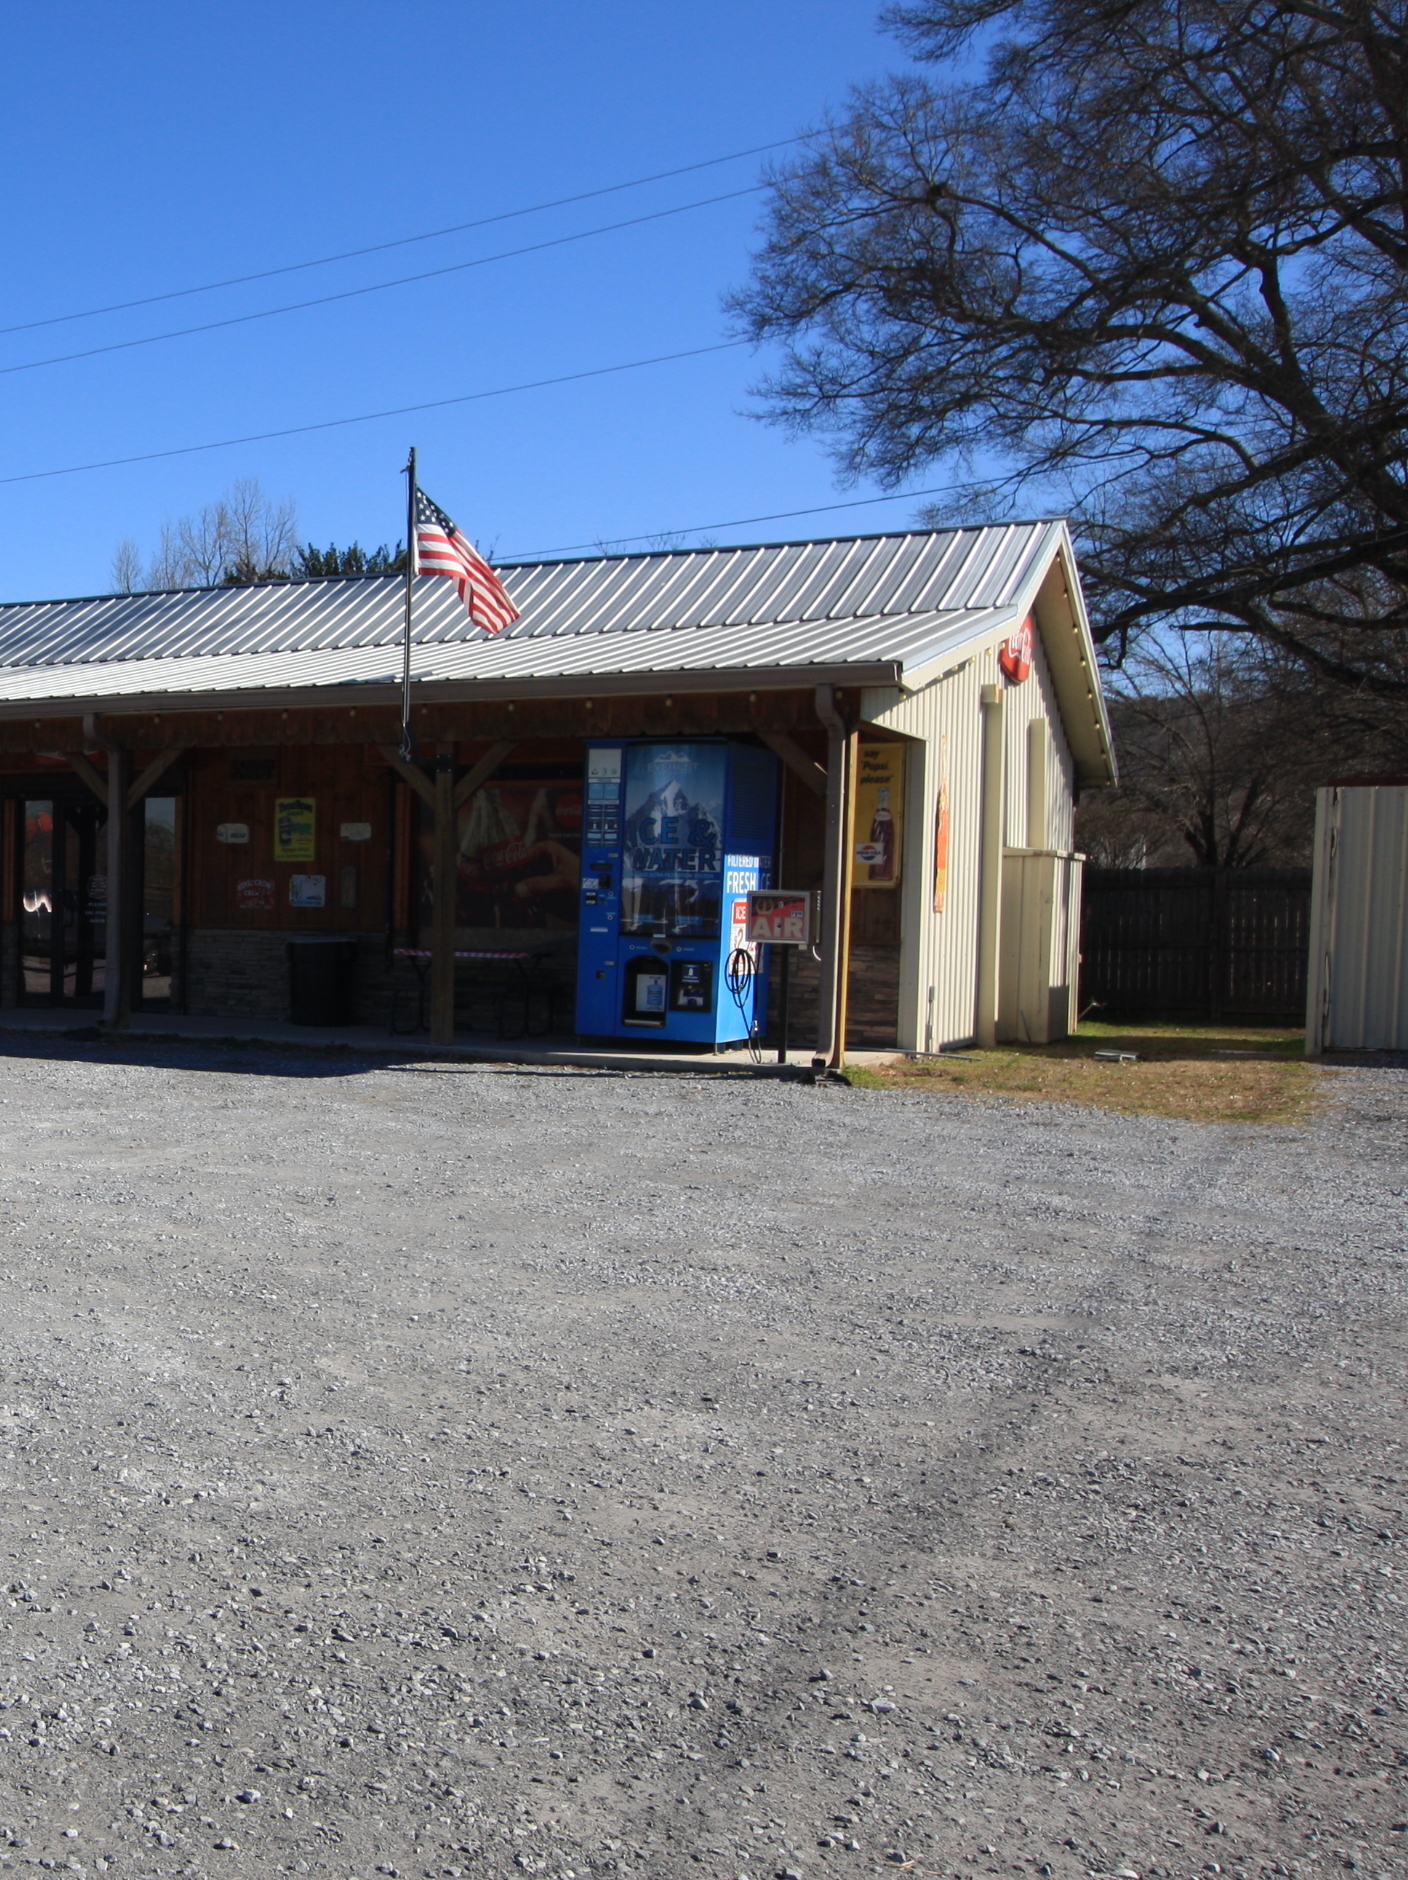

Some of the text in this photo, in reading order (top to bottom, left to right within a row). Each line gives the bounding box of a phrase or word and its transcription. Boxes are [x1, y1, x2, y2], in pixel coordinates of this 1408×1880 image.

[648, 762, 699, 771] EVEREST
[628, 817, 717, 848] ICE &
[632, 847, 717, 871] WATER
[726, 871, 757, 894] FRESH
[752, 917, 803, 938] AIR
